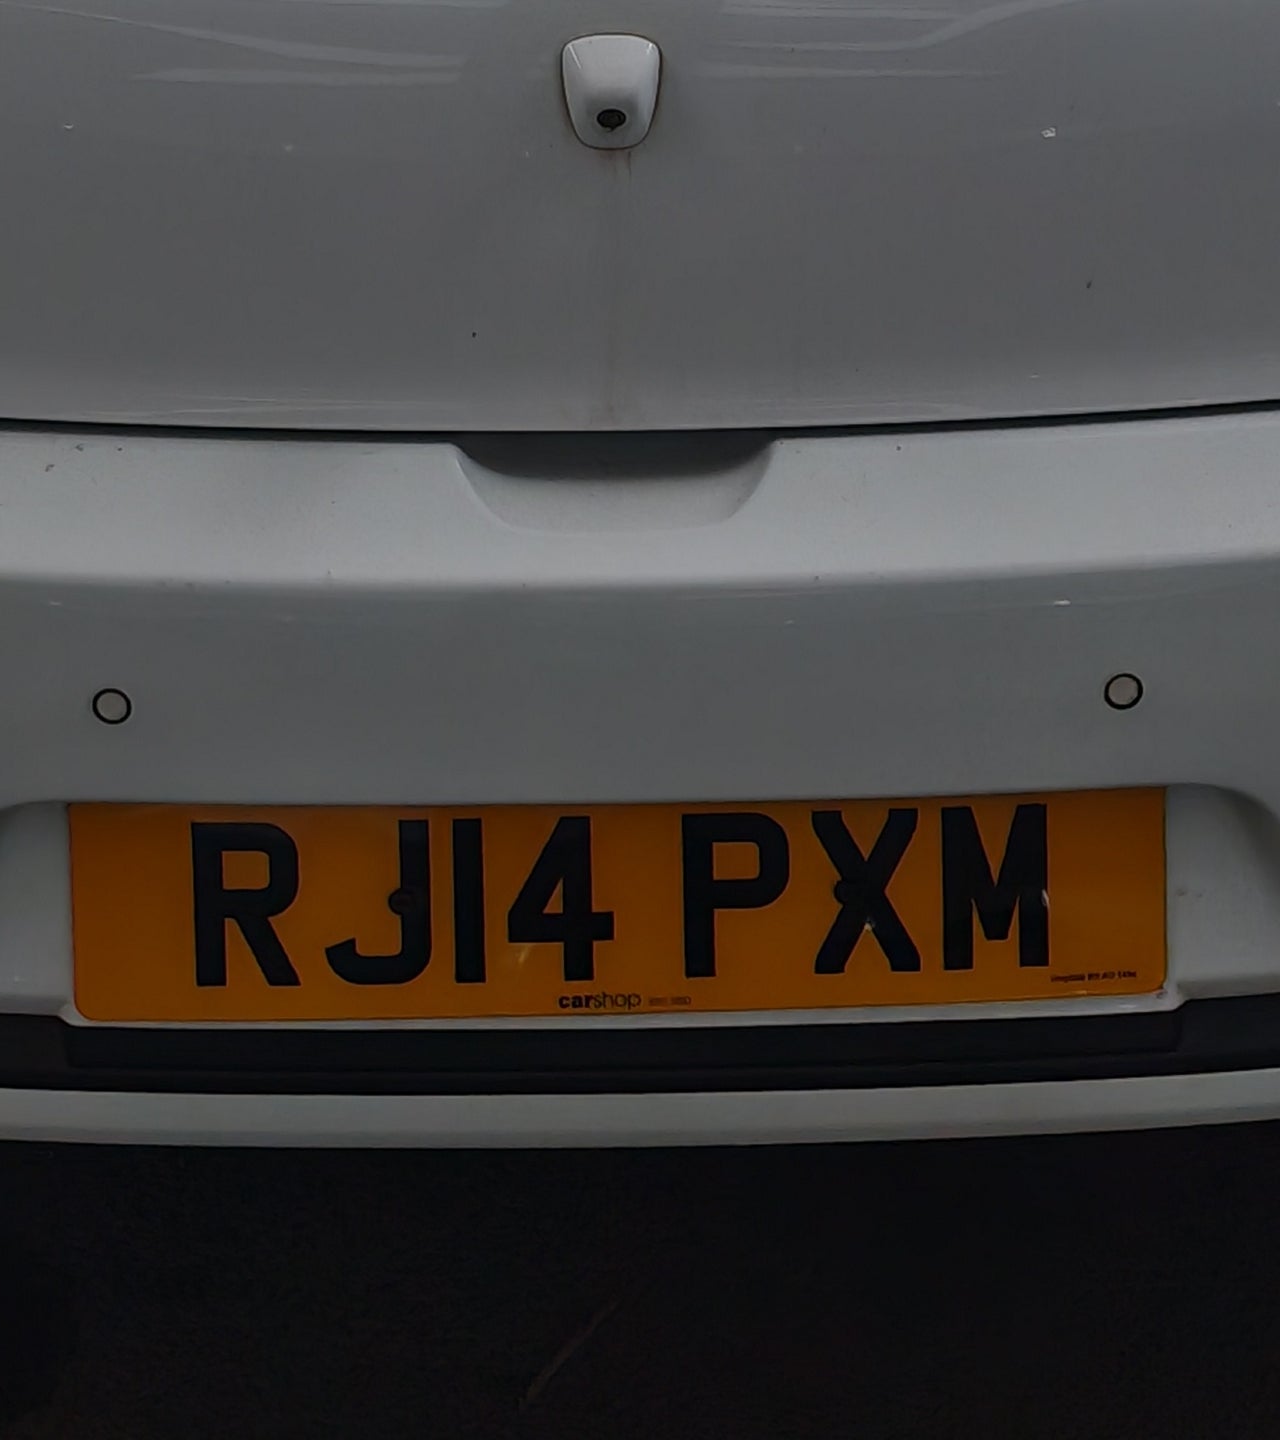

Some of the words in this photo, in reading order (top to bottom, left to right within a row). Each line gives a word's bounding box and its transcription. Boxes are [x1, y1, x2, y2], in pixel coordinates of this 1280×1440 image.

[190, 813, 615, 988] RJ14
[681, 802, 1050, 979] PXM
[557, 991, 642, 1010] carshop
